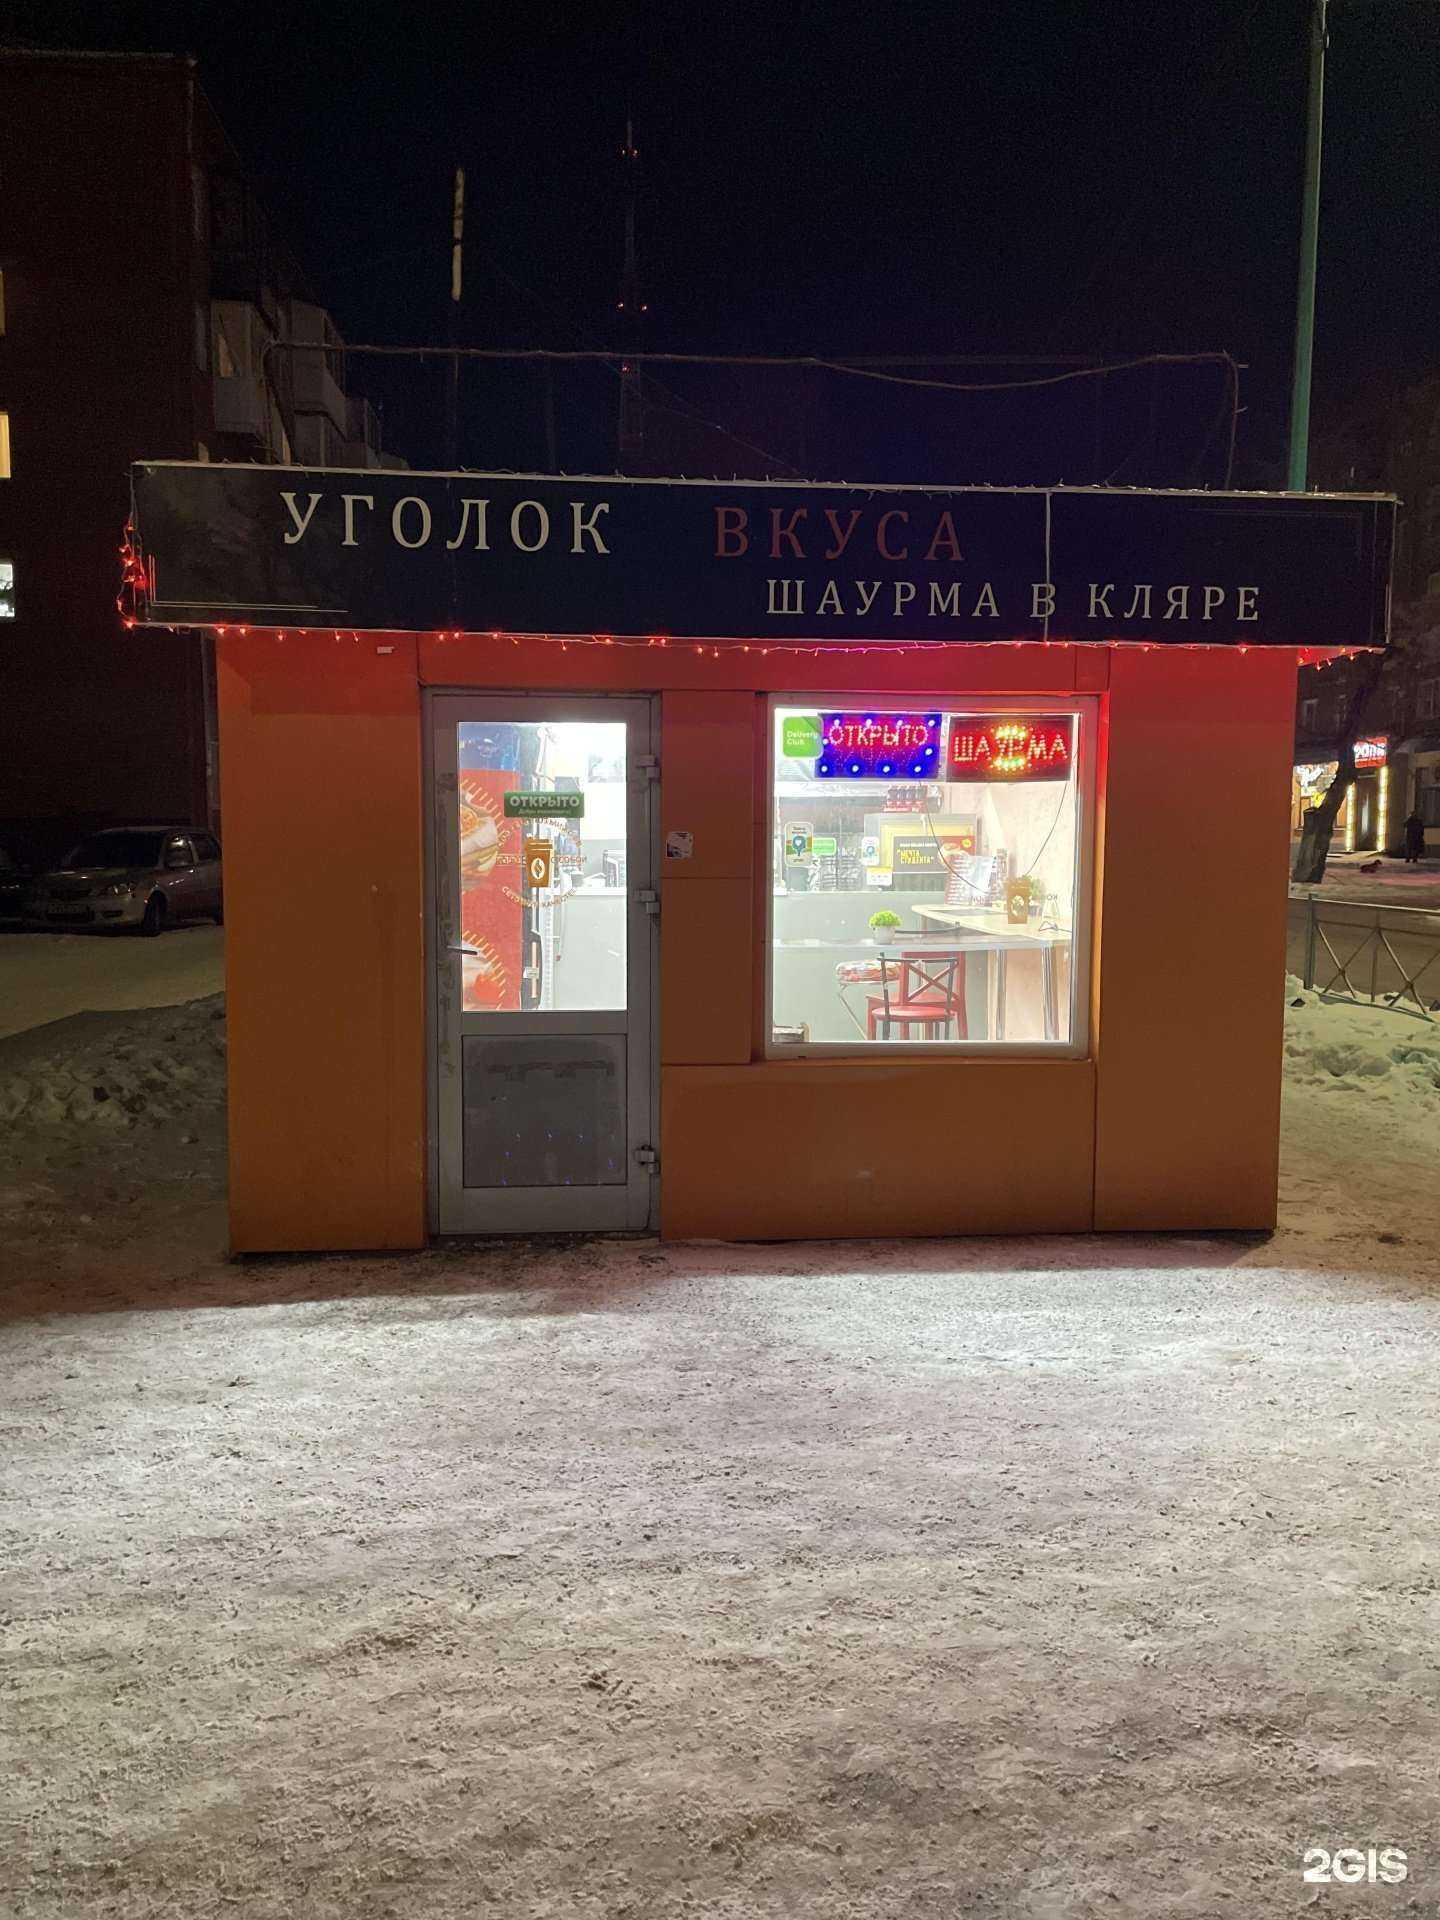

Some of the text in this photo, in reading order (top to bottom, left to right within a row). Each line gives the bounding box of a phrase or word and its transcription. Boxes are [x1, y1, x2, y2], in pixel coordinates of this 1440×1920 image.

[279, 491, 966, 561] УГОЛОК ВКУСА
[766, 579, 1259, 621] ШАУРМА В КЛЯРЕ
[829, 723, 929, 746] ОТКРЫТО
[954, 734, 1068, 762] ШАУРМА
[509, 796, 580, 807] ОТКРЫТО
